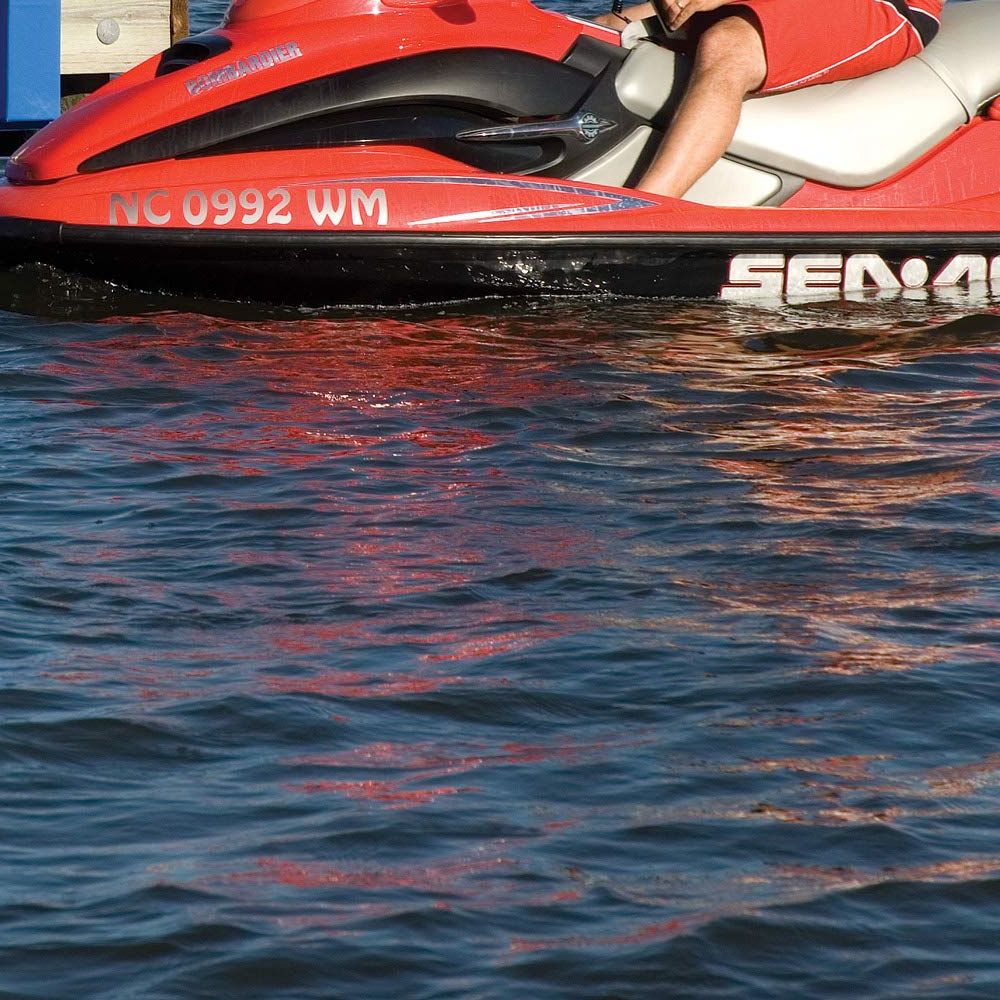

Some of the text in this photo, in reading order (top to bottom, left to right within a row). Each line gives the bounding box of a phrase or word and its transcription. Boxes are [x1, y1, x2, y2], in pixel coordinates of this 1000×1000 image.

[185, 41, 303, 96] BOMBARDIER
[109, 188, 388, 226] NC 0992 WM
